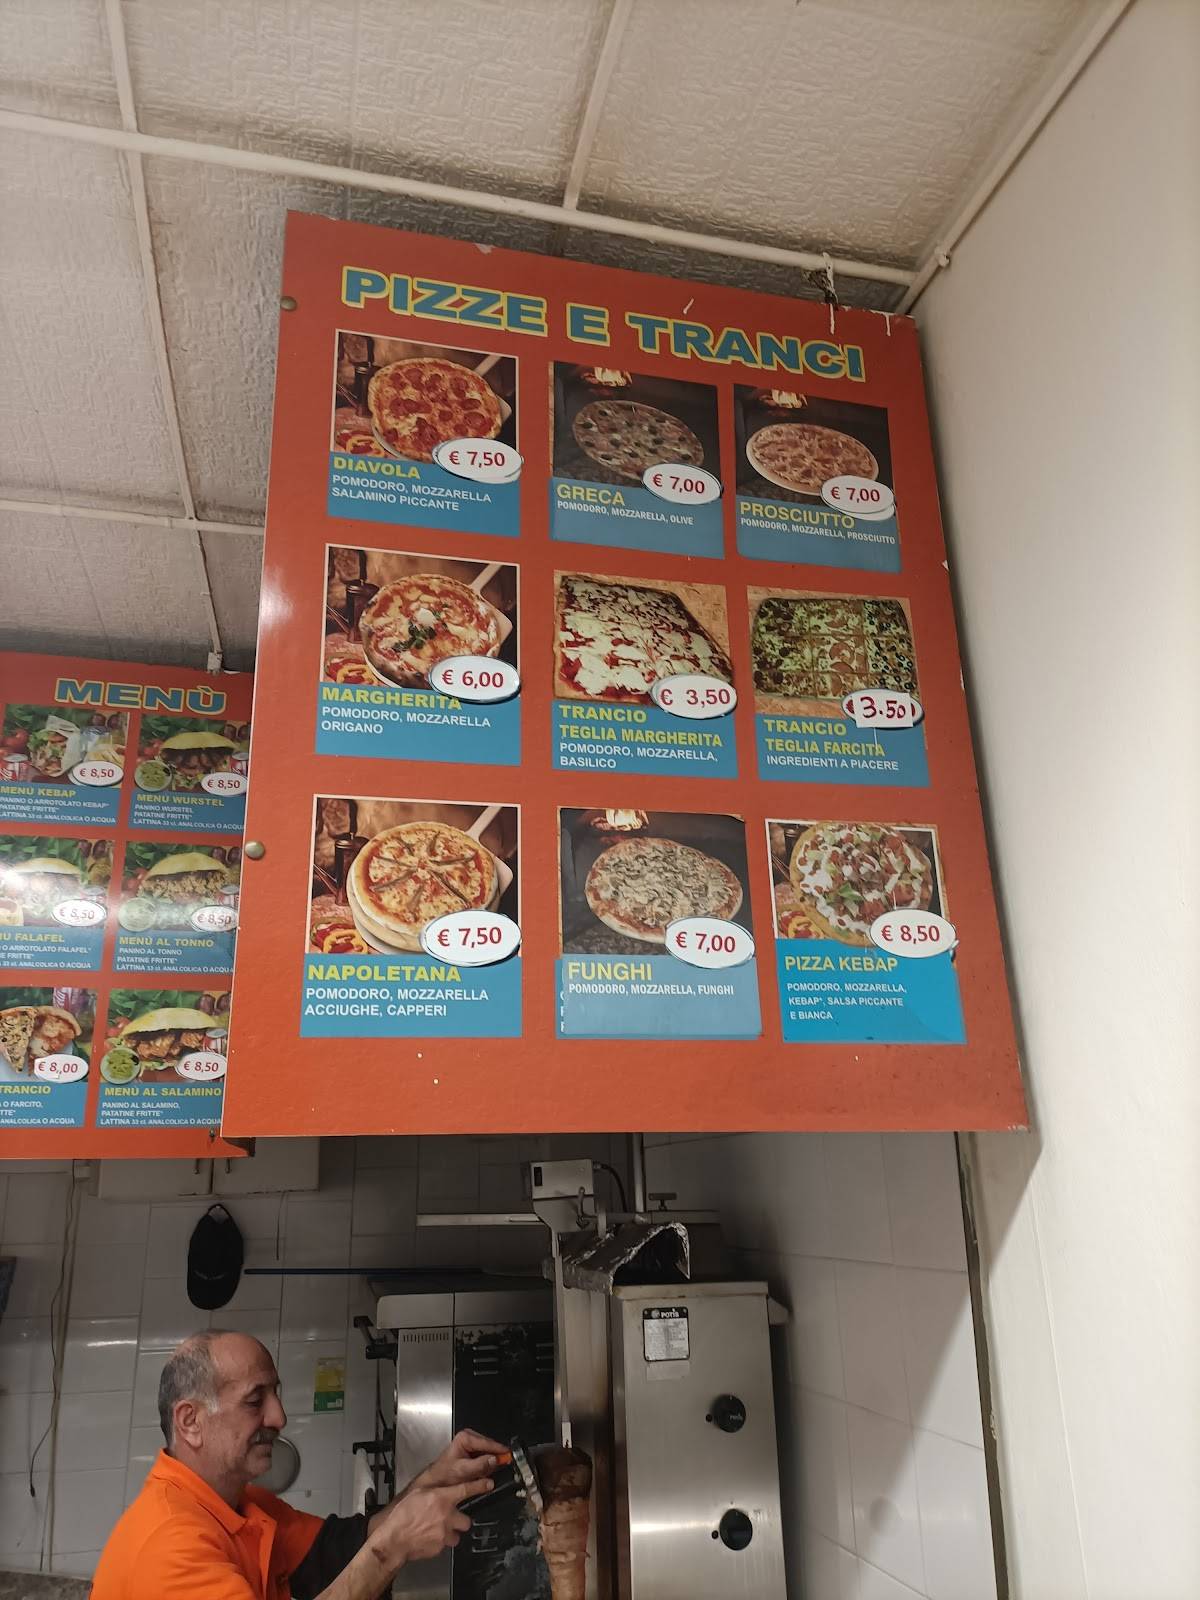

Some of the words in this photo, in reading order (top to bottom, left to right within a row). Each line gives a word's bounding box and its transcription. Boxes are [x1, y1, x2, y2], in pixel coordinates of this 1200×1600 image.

[341, 266, 548, 337] PIZZE
[567, 303, 610, 346] E
[626, 313, 867, 383] TRANCI
[333, 456, 421, 480] DIAVOLA
[448, 450, 461, 465] €
[467, 451, 506, 469] 7,50
[332, 474, 408, 494] POMODORO,
[411, 484, 492, 504] MOZZARELLA
[652, 473, 663, 487] €
[669, 476, 706, 494] 7,00
[331, 487, 397, 504] SALAMINO
[399, 495, 460, 511] PICCANTE
[556, 484, 626, 506] GRECA
[830, 486, 841, 500] €
[846, 487, 881, 503] 7,00
[557, 500, 610, 516] POMODORO,
[611, 508, 668, 524] MOZZARELLA,
[670, 514, 694, 525] OLIVE
[740, 502, 855, 529] PROSCIUTTO
[740, 517, 791, 533] POMODORO,
[791, 524, 846, 540] MOZZARELLA,
[847, 531, 896, 545] PROSCIUTTO
[441, 670, 454, 685] €
[462, 670, 504, 689] 6,00
[55, 678, 227, 716] MENÙ
[322, 686, 462, 711] MARGHERITA
[660, 688, 673, 706] €
[686, 688, 731, 708] 3,50
[559, 704, 647, 723] TRANCIO
[860, 696, 906, 719] 3.50
[322, 706, 403, 723] POMODORO,
[406, 712, 491, 728] MOZZARELLA
[320, 720, 384, 735] ORIGANO
[559, 724, 617, 740] TEGLIA
[621, 728, 723, 748] MARGHERITA
[763, 719, 847, 737] TRANCIO
[559, 742, 634, 758] POMODORO,
[636, 747, 718, 762] MOZZARELLA,
[764, 738, 820, 754] TEGLIA
[823, 740, 886, 757] FARCITA
[559, 756, 617, 769] BASILICO
[766, 755, 838, 768] INGREDIENTI
[840, 758, 849, 769] A
[850, 759, 899, 771] PIACERE
[79, 768, 86, 777] €
[90, 768, 115, 779] 8,50
[38, 788, 76, 798] KEBAP
[207, 780, 214, 788] €
[217, 780, 241, 790] 8,50
[161, 805, 193, 813] WURSTEL
[172, 796, 225, 807] WURSTEL
[133, 818, 162, 826] LATTINA
[134, 811, 164, 819] PATATINE
[15, 933, 65, 943] FALAFEL
[156, 938, 170, 946] AL
[174, 938, 214, 948] TONNO
[437, 928, 450, 947] €
[458, 926, 502, 949] 7,50
[676, 931, 688, 948] €
[695, 933, 736, 954] 7,00
[881, 925, 893, 942] €
[900, 925, 940, 945] 8,50
[117, 956, 150, 964] PATATINE
[119, 947, 146, 955] PANINO
[157, 948, 183, 956] TONNO
[567, 961, 653, 981] FUNGHI
[784, 955, 835, 971] PIZZA
[838, 956, 899, 972] KEBAP
[307, 964, 462, 982] NAPOLETANA
[306, 987, 394, 1002] POMODORO,
[397, 988, 489, 1001] MOZZARELLA
[568, 983, 629, 996] POMODORO,
[630, 984, 697, 996] MOZZARELLA,
[698, 984, 735, 996] FUNGHI
[786, 982, 844, 993] POMODORO,
[844, 983, 907, 993] MOZZARELLA,
[304, 1004, 384, 1017] ACCIUGHE,
[386, 1004, 447, 1016] CAPPERI
[827, 997, 857, 1006] SALSA
[858, 997, 904, 1007] PICCANTE
[790, 1011, 797, 1020] E
[798, 1011, 834, 1020] BIANCA
[38, 1062, 46, 1072] €
[183, 1061, 190, 1071] €
[194, 1061, 219, 1073] 8,50
[142, 1088, 158, 1096] AL
[161, 1087, 222, 1096] SALAMINO
[42, 1117, 49, 1125] O
